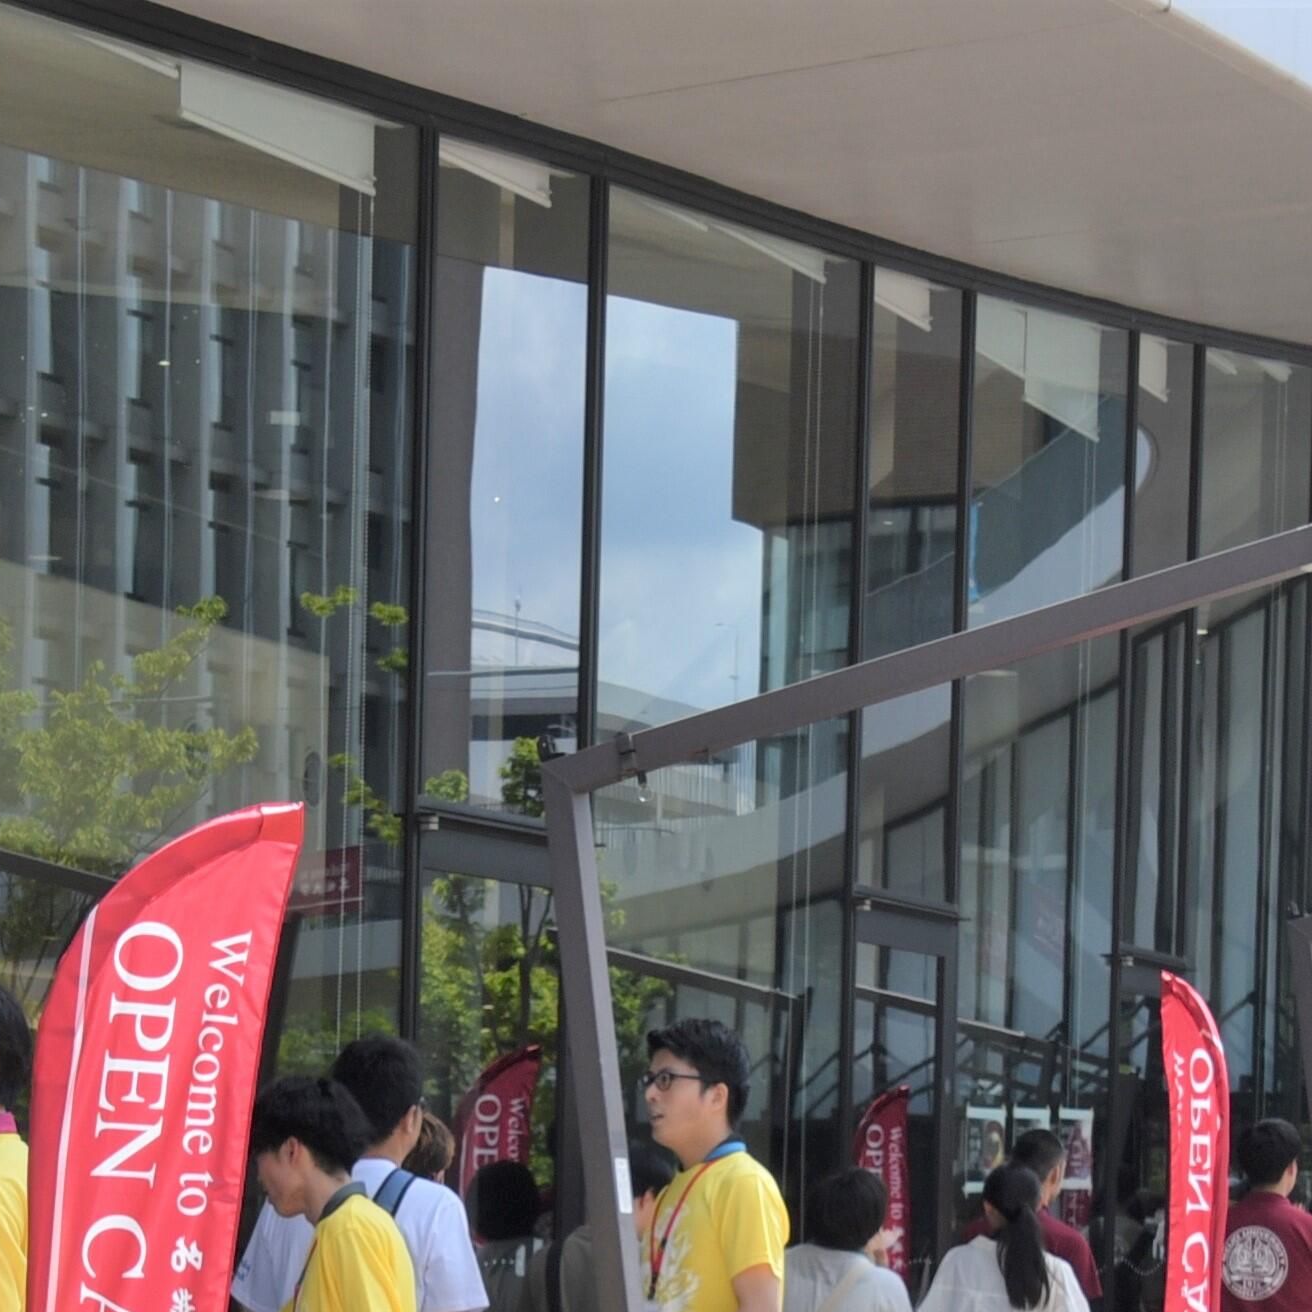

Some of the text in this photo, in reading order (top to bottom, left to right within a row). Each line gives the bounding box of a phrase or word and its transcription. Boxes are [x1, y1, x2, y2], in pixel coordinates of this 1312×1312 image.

[90, 920, 185, 1188] OPEN
[182, 929, 254, 1155] Welcome
[177, 1171, 214, 1217] to
[473, 1093, 503, 1170] OPE
